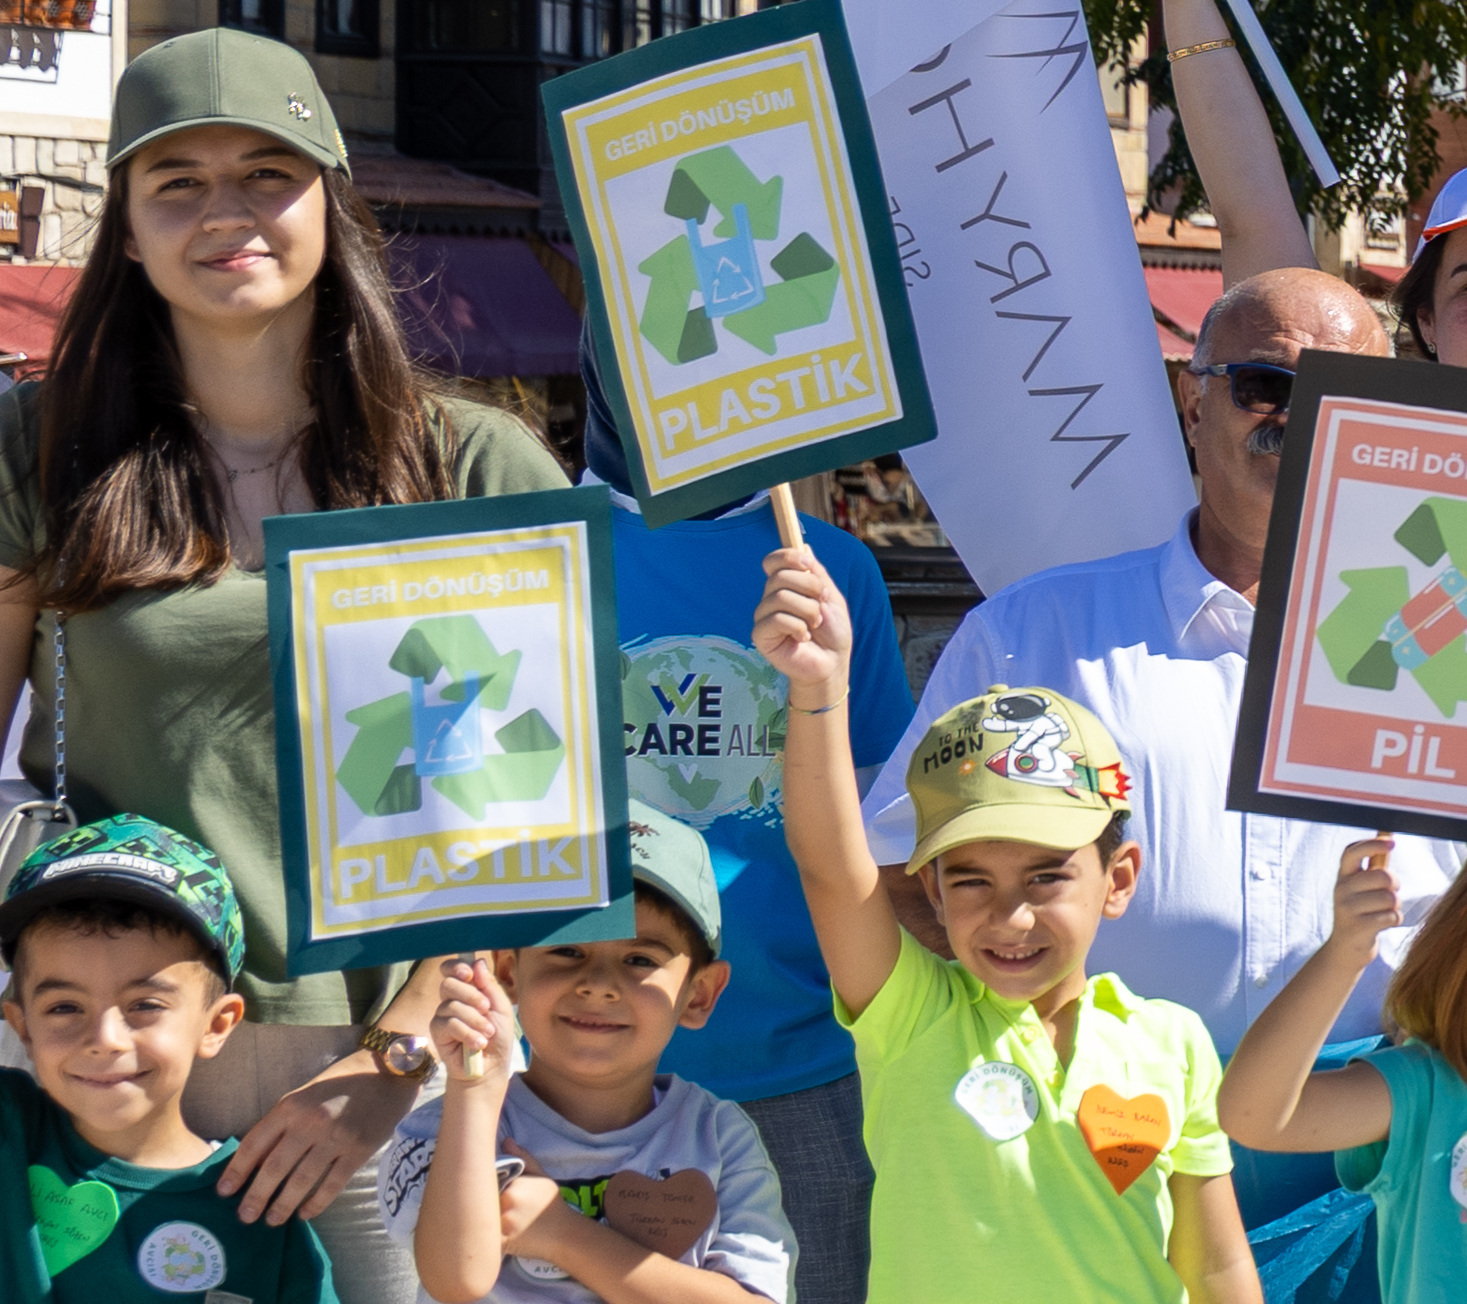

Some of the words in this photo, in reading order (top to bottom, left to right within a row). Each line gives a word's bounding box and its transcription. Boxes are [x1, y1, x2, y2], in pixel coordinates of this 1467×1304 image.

[605, 122, 658, 162] GERİ
[660, 88, 796, 140] DÖNÜŞÜM
[658, 352, 871, 450] PLASTİK
[1351, 444, 1419, 472] GERİ
[331, 580, 399, 610] GERİ
[402, 568, 550, 602] DÖNÜŞÜM
[650, 673, 723, 720] WE
[726, 724, 778, 758] ALL
[923, 733, 984, 775] MOON
[938, 732, 952, 746] TO
[957, 723, 980, 739] THE
[1371, 723, 1458, 780] PİL
[43, 852, 179, 884] MINECRAFT
[338, 828, 578, 899] PLASTİK
